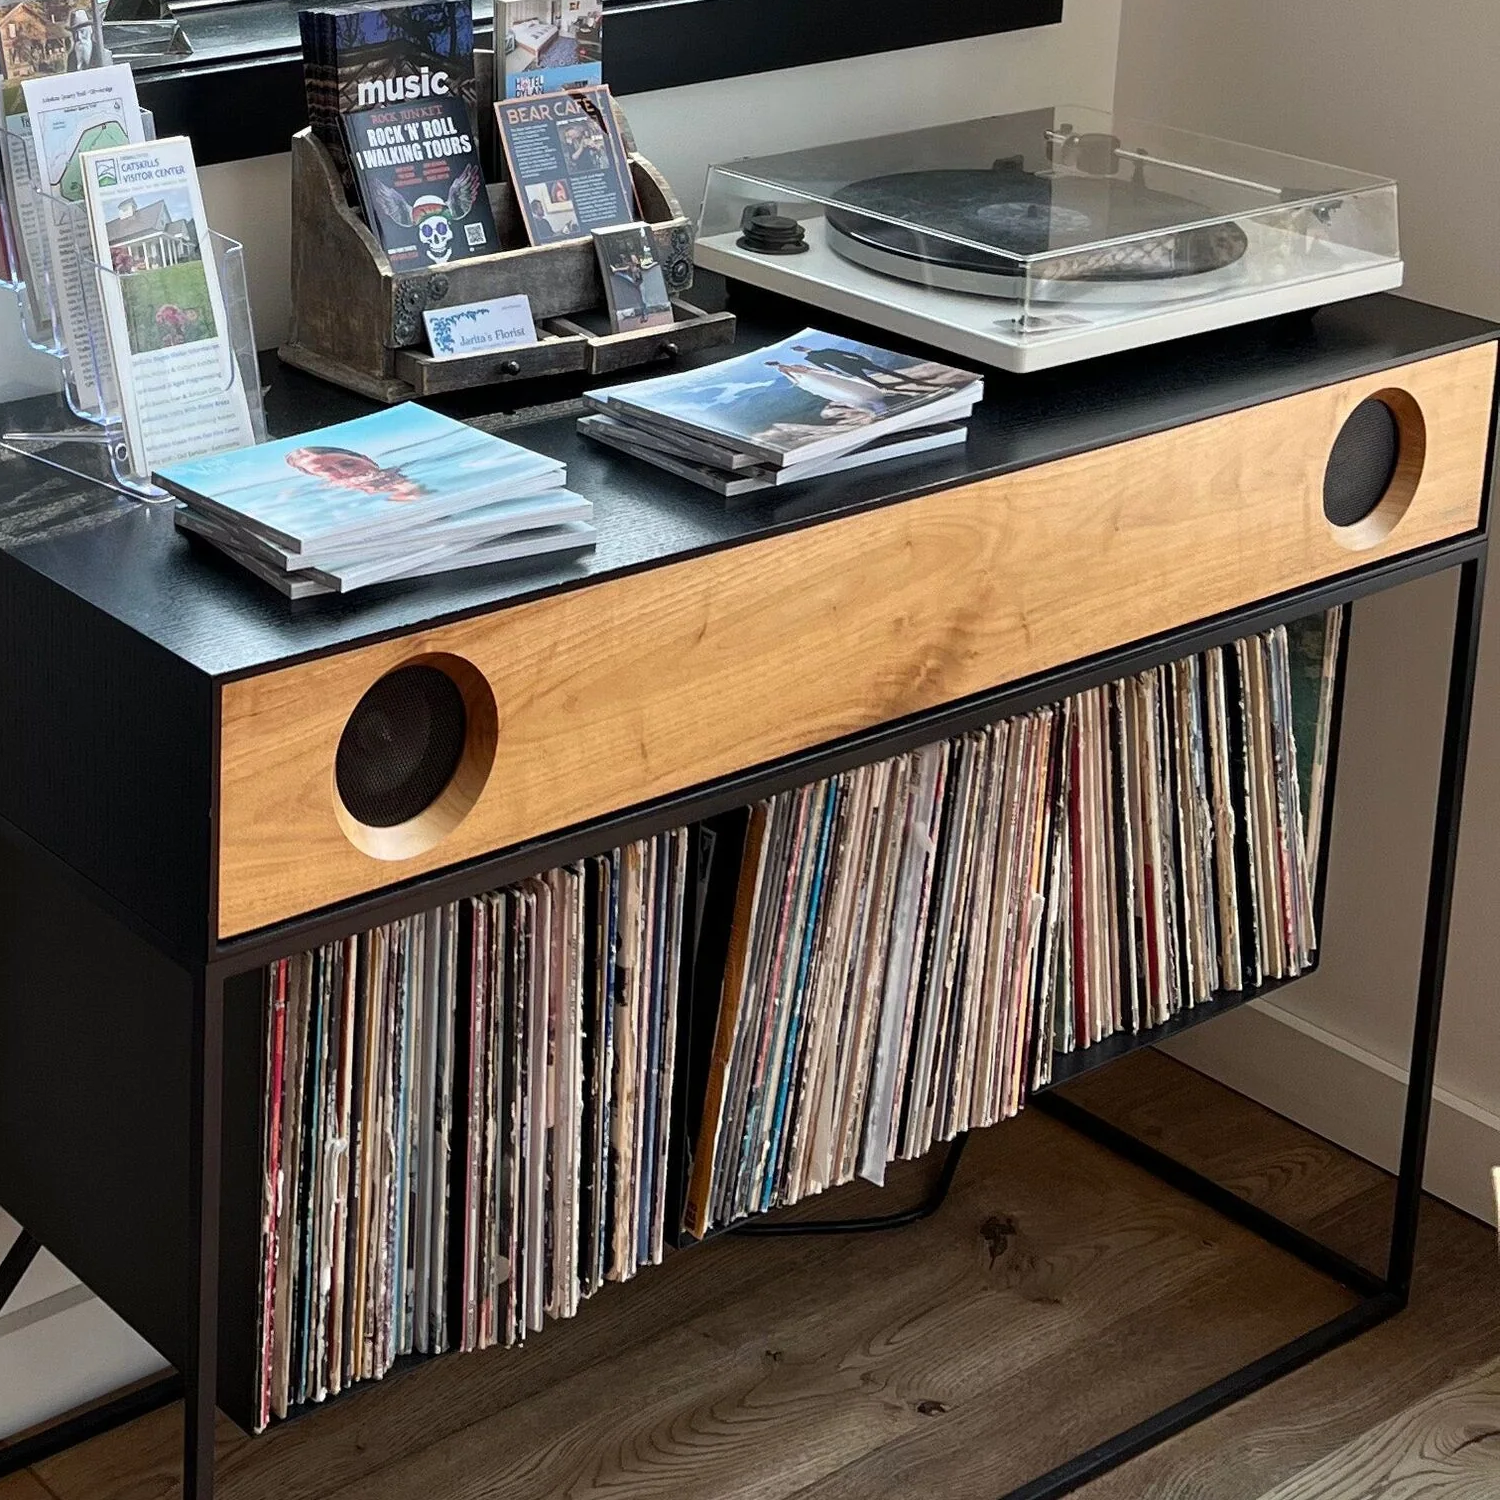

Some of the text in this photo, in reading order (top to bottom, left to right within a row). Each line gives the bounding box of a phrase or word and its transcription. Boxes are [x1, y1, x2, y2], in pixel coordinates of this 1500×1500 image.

[358, 66, 449, 106] music
[515, 75, 544, 91] HOTEL
[370, 105, 443, 124] ROCK JUNKET
[506, 105, 553, 125] BEAR
[367, 125, 405, 147] ROCK
[421, 117, 457, 139] ROLL
[363, 142, 424, 169] WALKING
[423, 134, 472, 159] TOURS
[121, 158, 160, 172] CATSKILLS
[123, 165, 186, 183] VISITOR CENTER
[494, 327, 526, 341] Florist
